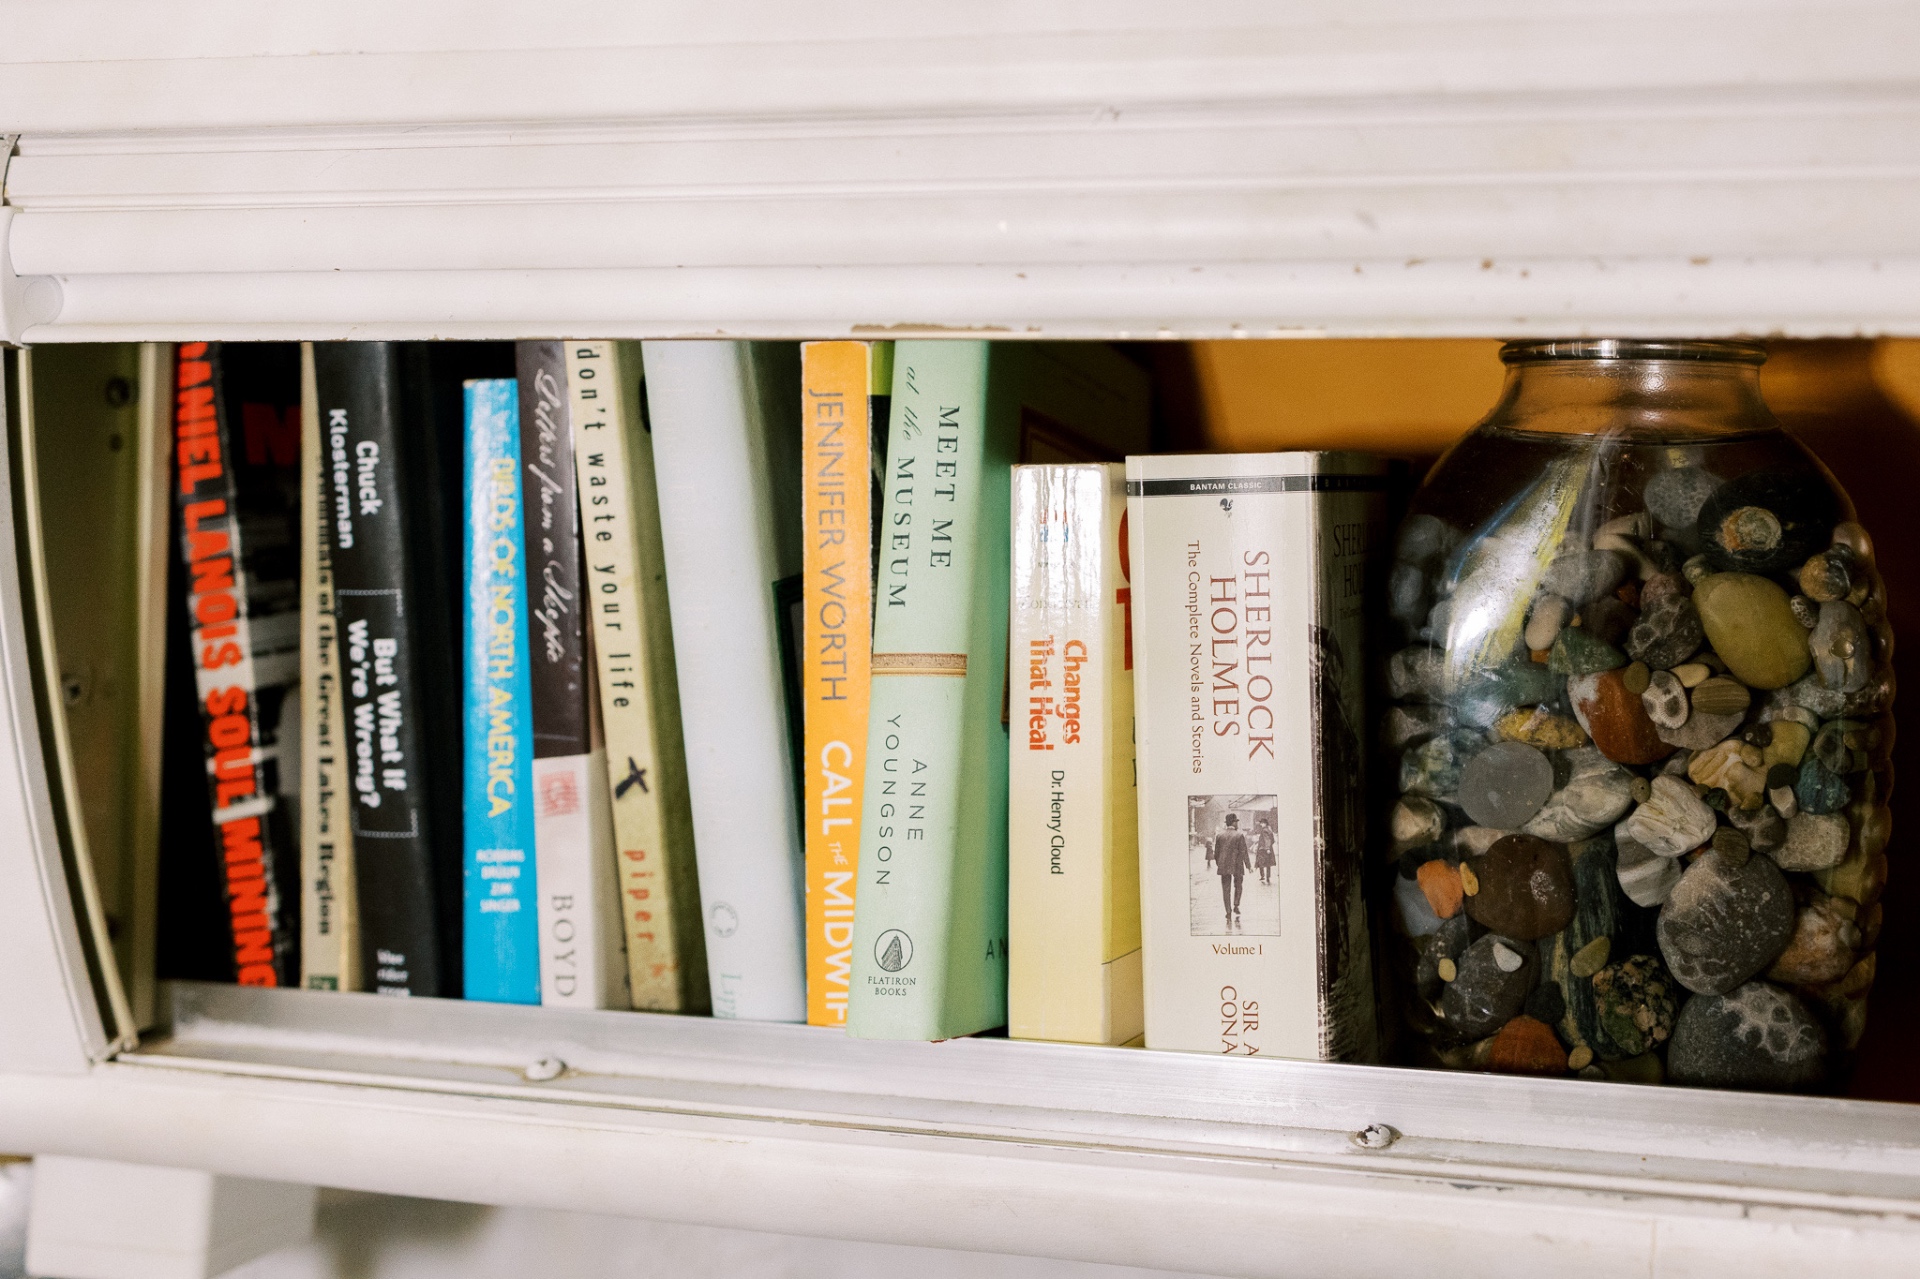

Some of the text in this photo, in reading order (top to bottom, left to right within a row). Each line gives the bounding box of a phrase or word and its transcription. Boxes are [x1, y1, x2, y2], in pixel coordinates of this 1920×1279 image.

[177, 341, 242, 672] DANIEL LANOIS
[329, 408, 354, 549] Klosterman
[355, 440, 383, 516] Chuck
[489, 457, 516, 532] BIRDS
[528, 368, 574, 663] Letters from a Skeptic
[576, 348, 635, 708] don't waste your life
[888, 366, 923, 608] at the MUSEUM
[930, 405, 961, 568] MEET ME
[1189, 481, 1262, 491] BANTAM CLASSIC
[488, 537, 516, 578] OF
[808, 388, 848, 701] JENNIFER WORTH
[318, 592, 334, 617] of
[318, 624, 336, 665] the
[488, 584, 516, 679] NORTH
[1185, 540, 1204, 774] The Complete Novels and Stories
[1209, 574, 1240, 737] HOLMES
[1243, 550, 1275, 761] SHERLOCK
[317, 673, 334, 747] Great
[348, 619, 381, 809] We're Wrong?
[373, 638, 407, 791] But What If
[1029, 635, 1055, 750] That Heal
[1055, 639, 1088, 744] Changes
[318, 756, 334, 833] Lakes
[487, 685, 516, 818] AMERICA
[876, 713, 902, 885] YOUNGSON
[907, 758, 928, 841] ANNE
[206, 686, 277, 988] SOUL MINING
[1047, 770, 1065, 875] Dr. Henry Cloud
[315, 843, 335, 935] Region
[623, 850, 655, 942] piper
[821, 740, 855, 1022] CALL THE MIDWIF
[552, 895, 577, 997] BOYD
[867, 976, 917, 986] FLATIRON
[874, 987, 907, 996] BOOKS
[1212, 943, 1256, 955] Volume
[1220, 985, 1238, 1054] CONA
[1242, 1000, 1259, 1032] SIR
